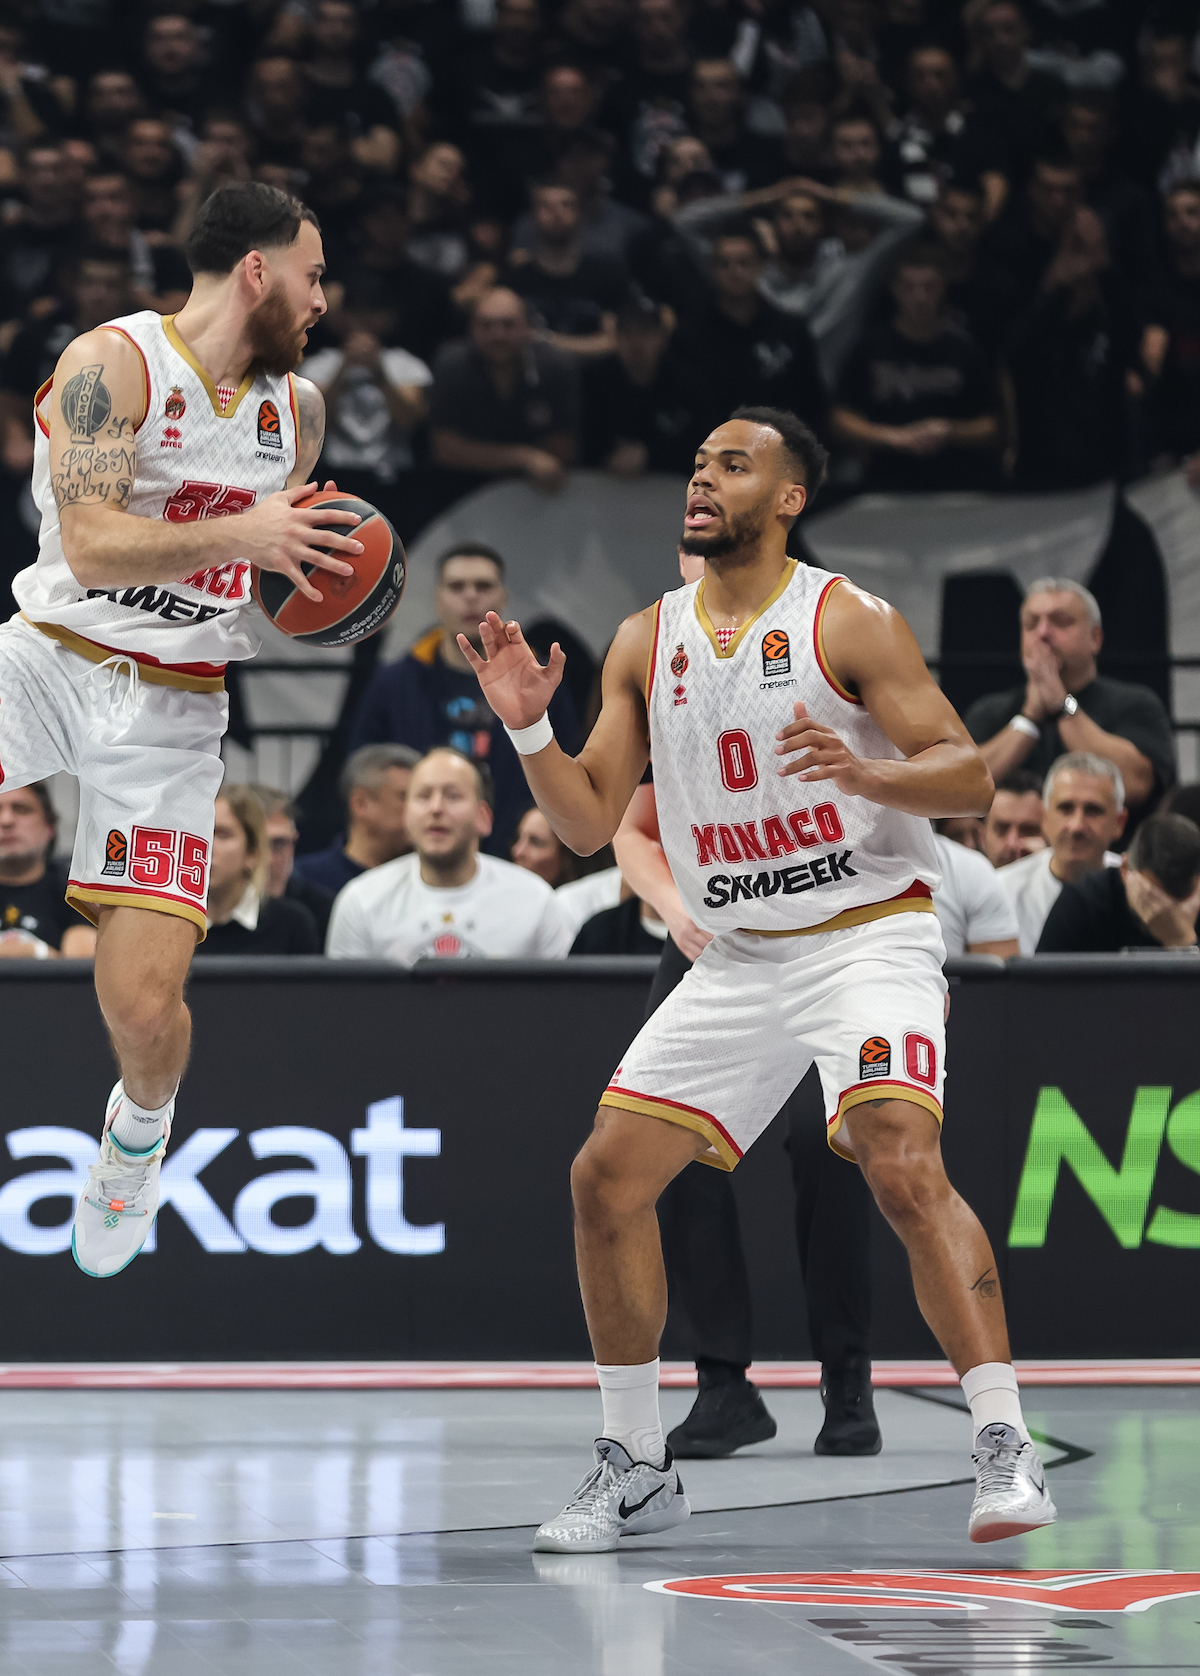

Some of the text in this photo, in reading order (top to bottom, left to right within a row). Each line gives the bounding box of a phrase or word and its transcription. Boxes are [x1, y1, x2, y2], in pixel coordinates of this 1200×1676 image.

[717, 728, 758, 792] 0
[128, 824, 209, 900] 55
[691, 801, 845, 867] MONACO
[902, 1031, 938, 1090] 0
